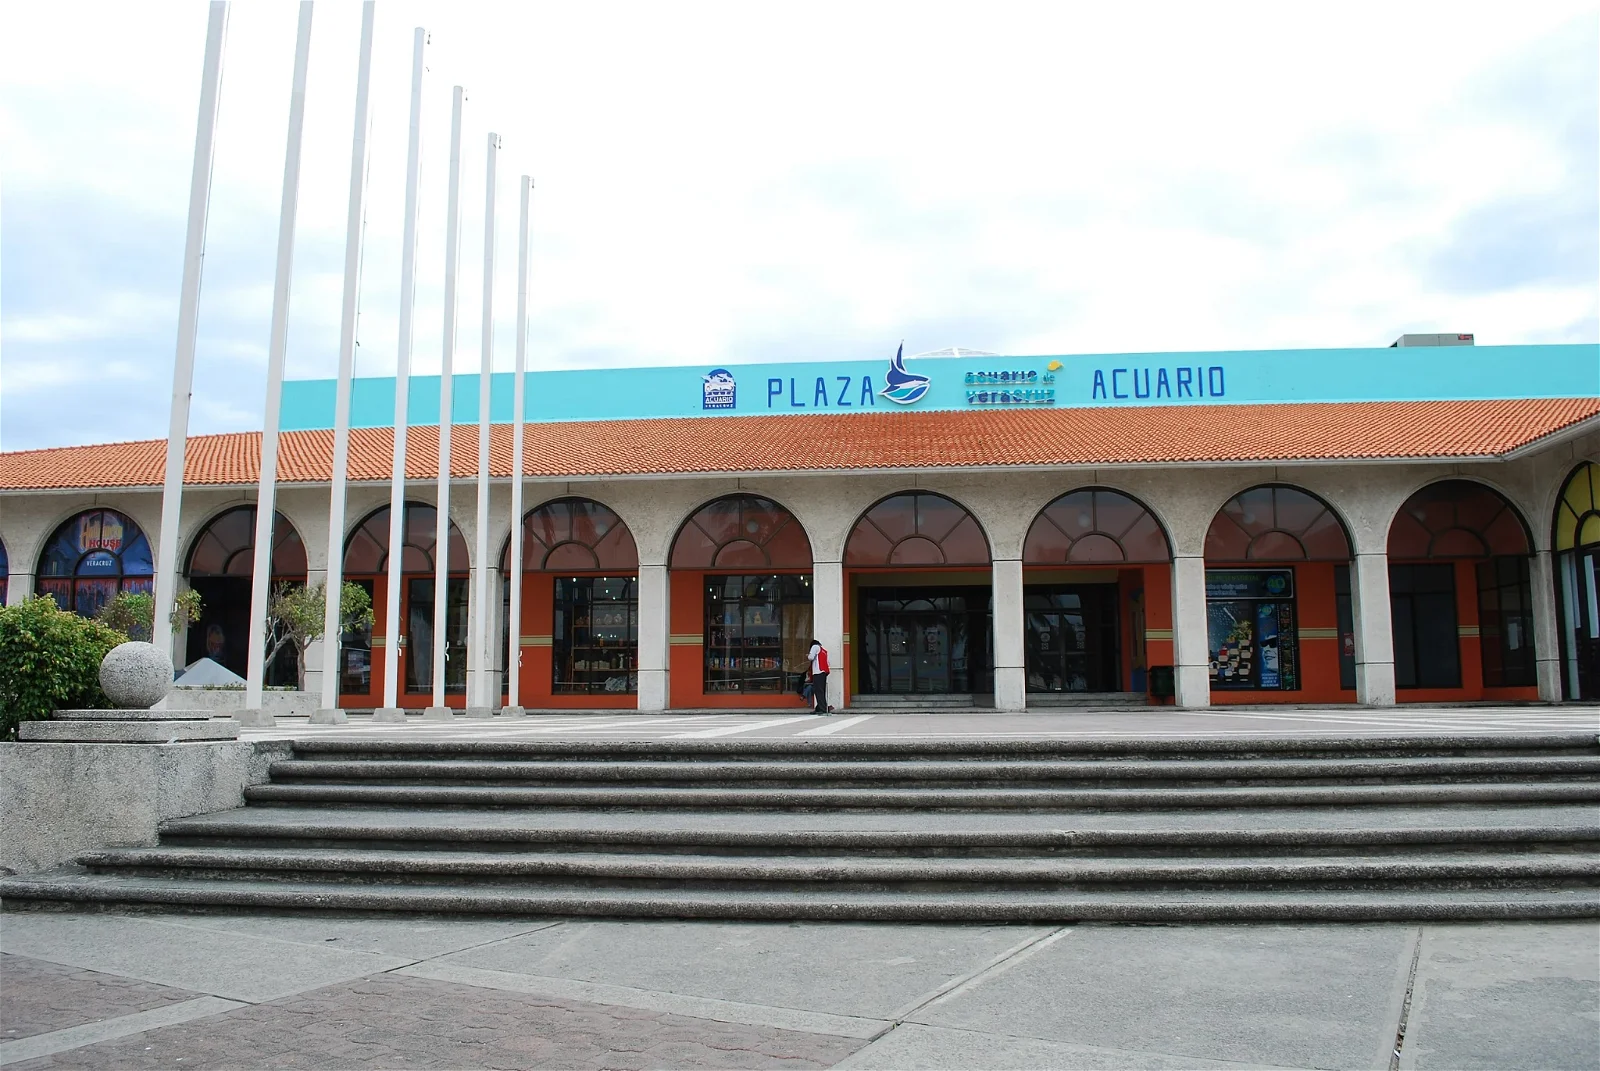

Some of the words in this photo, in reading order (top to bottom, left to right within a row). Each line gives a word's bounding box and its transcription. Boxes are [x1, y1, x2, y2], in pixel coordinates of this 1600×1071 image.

[964, 370, 1038, 385] acuario
[1042, 372, 1055, 384] de
[768, 376, 874, 408] PLAZA
[1093, 366, 1224, 399] ACUARIO
[966, 389, 1055, 404] veracruz
[88, 539, 121, 549] HOUSE
